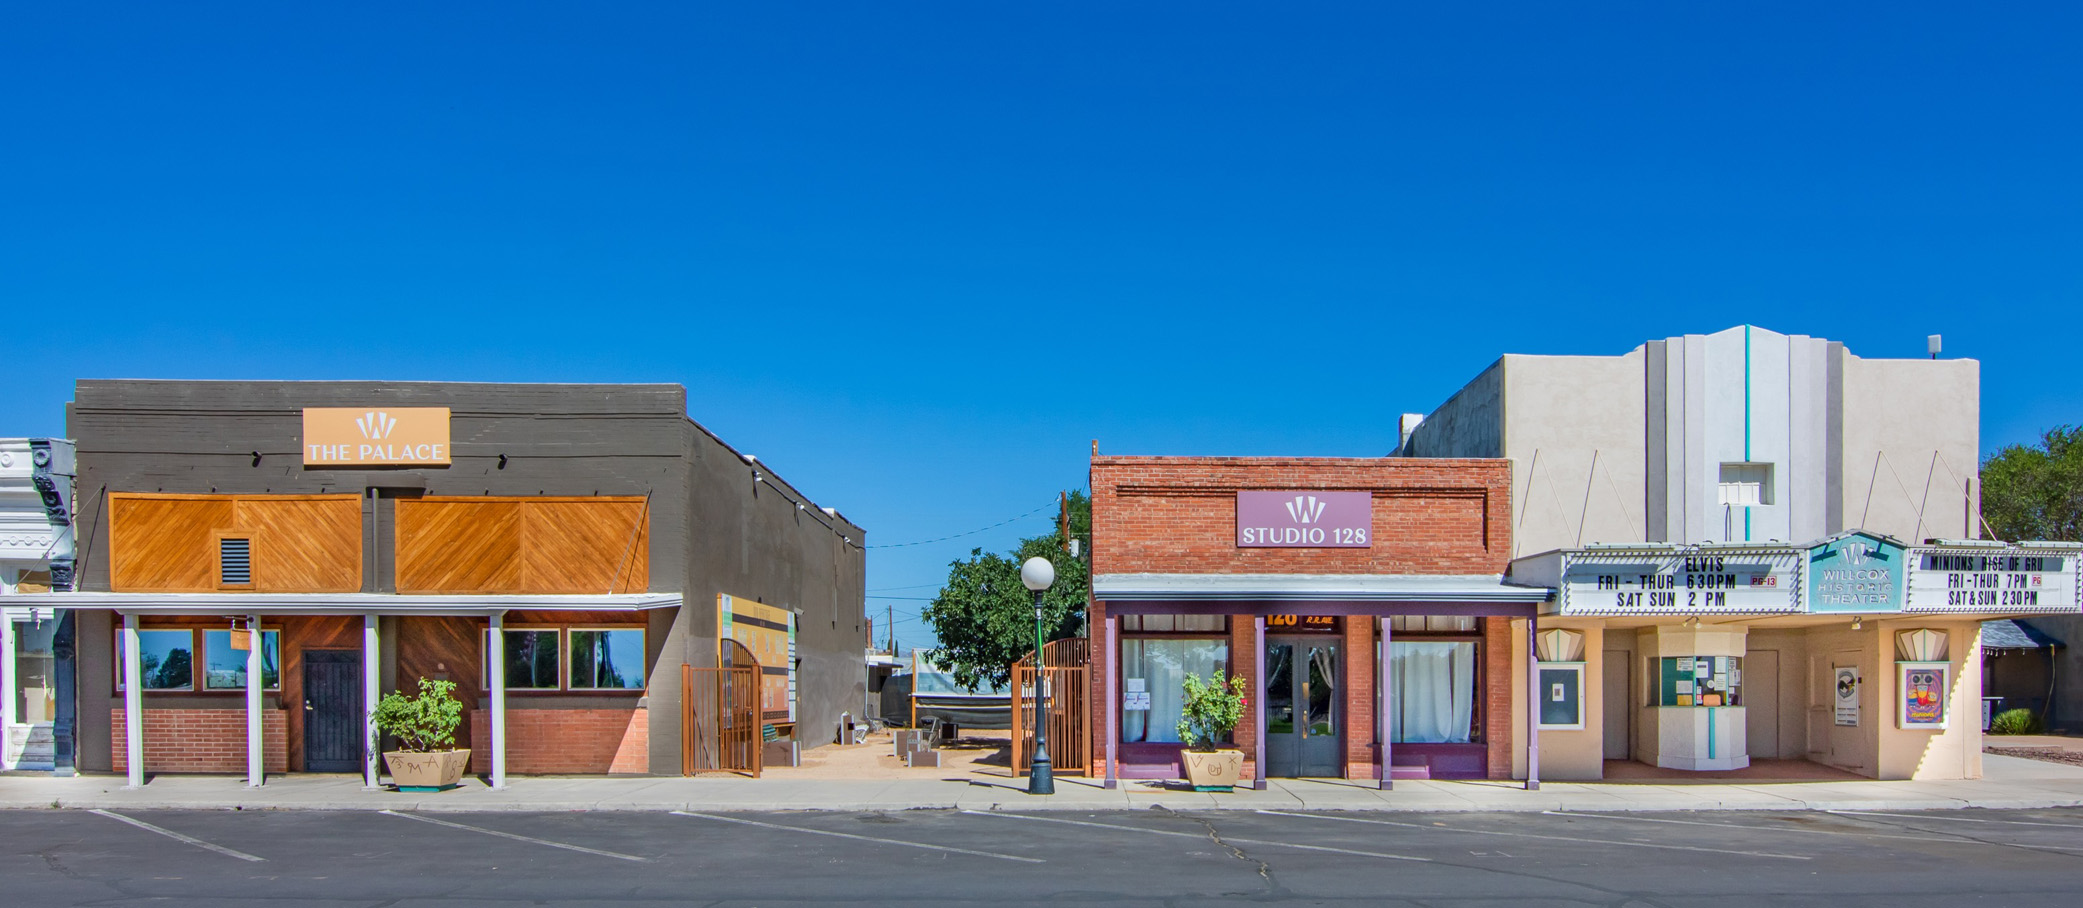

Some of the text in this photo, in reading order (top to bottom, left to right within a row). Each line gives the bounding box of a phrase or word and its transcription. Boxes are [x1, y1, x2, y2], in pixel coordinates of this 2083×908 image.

[308, 444, 444, 461] THE PALACE
[1242, 527, 1367, 544] STUDIO 128
[1685, 557, 1724, 572] ELVIS
[1930, 556, 2043, 571] MINIONS RISE OF GRU
[1598, 575, 1619, 590] FRI
[1640, 574, 1674, 590] THUR
[1686, 574, 1736, 590] 630PM
[1751, 577, 1776, 586] PG-13
[1823, 569, 1889, 581] WILLCOX
[2032, 576, 2041, 585] PG
[1818, 583, 1893, 592] HISTORIC
[1617, 592, 1726, 607] SAT SUN 2 PM
[1821, 593, 1890, 604] THEATER
